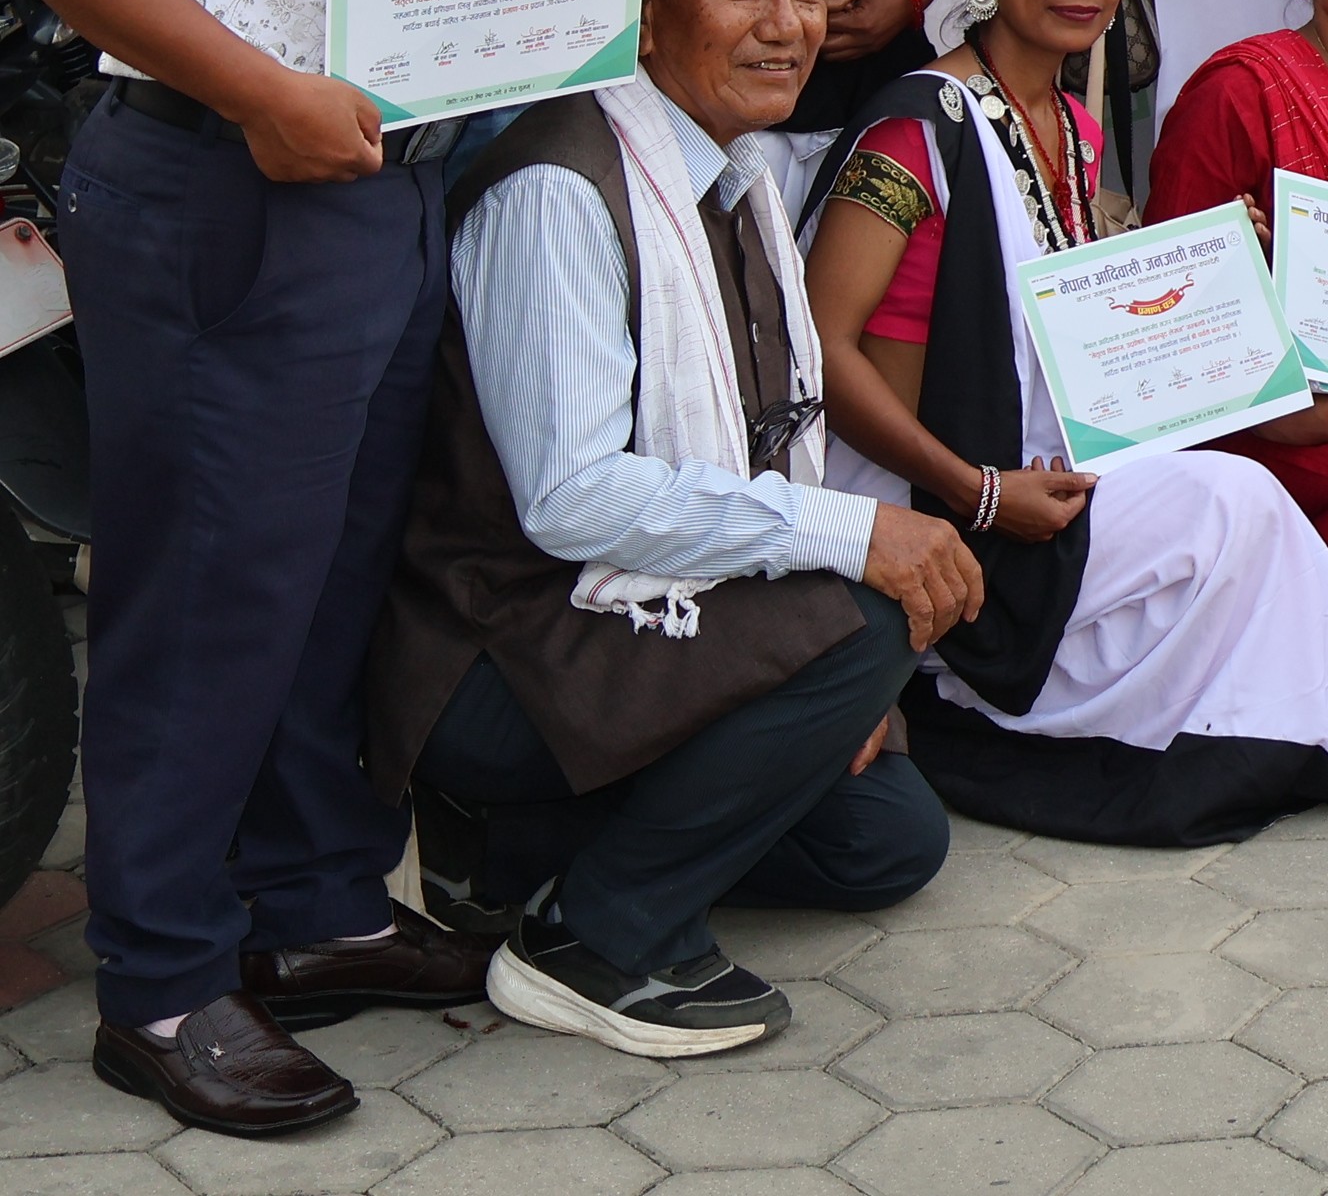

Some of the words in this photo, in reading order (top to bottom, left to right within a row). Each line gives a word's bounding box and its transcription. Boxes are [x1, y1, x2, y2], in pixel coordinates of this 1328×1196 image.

[1057, 275, 1092, 295] नेपाल
[1091, 257, 1143, 286] आदिवासी
[1187, 236, 1227, 258] महासंघ
